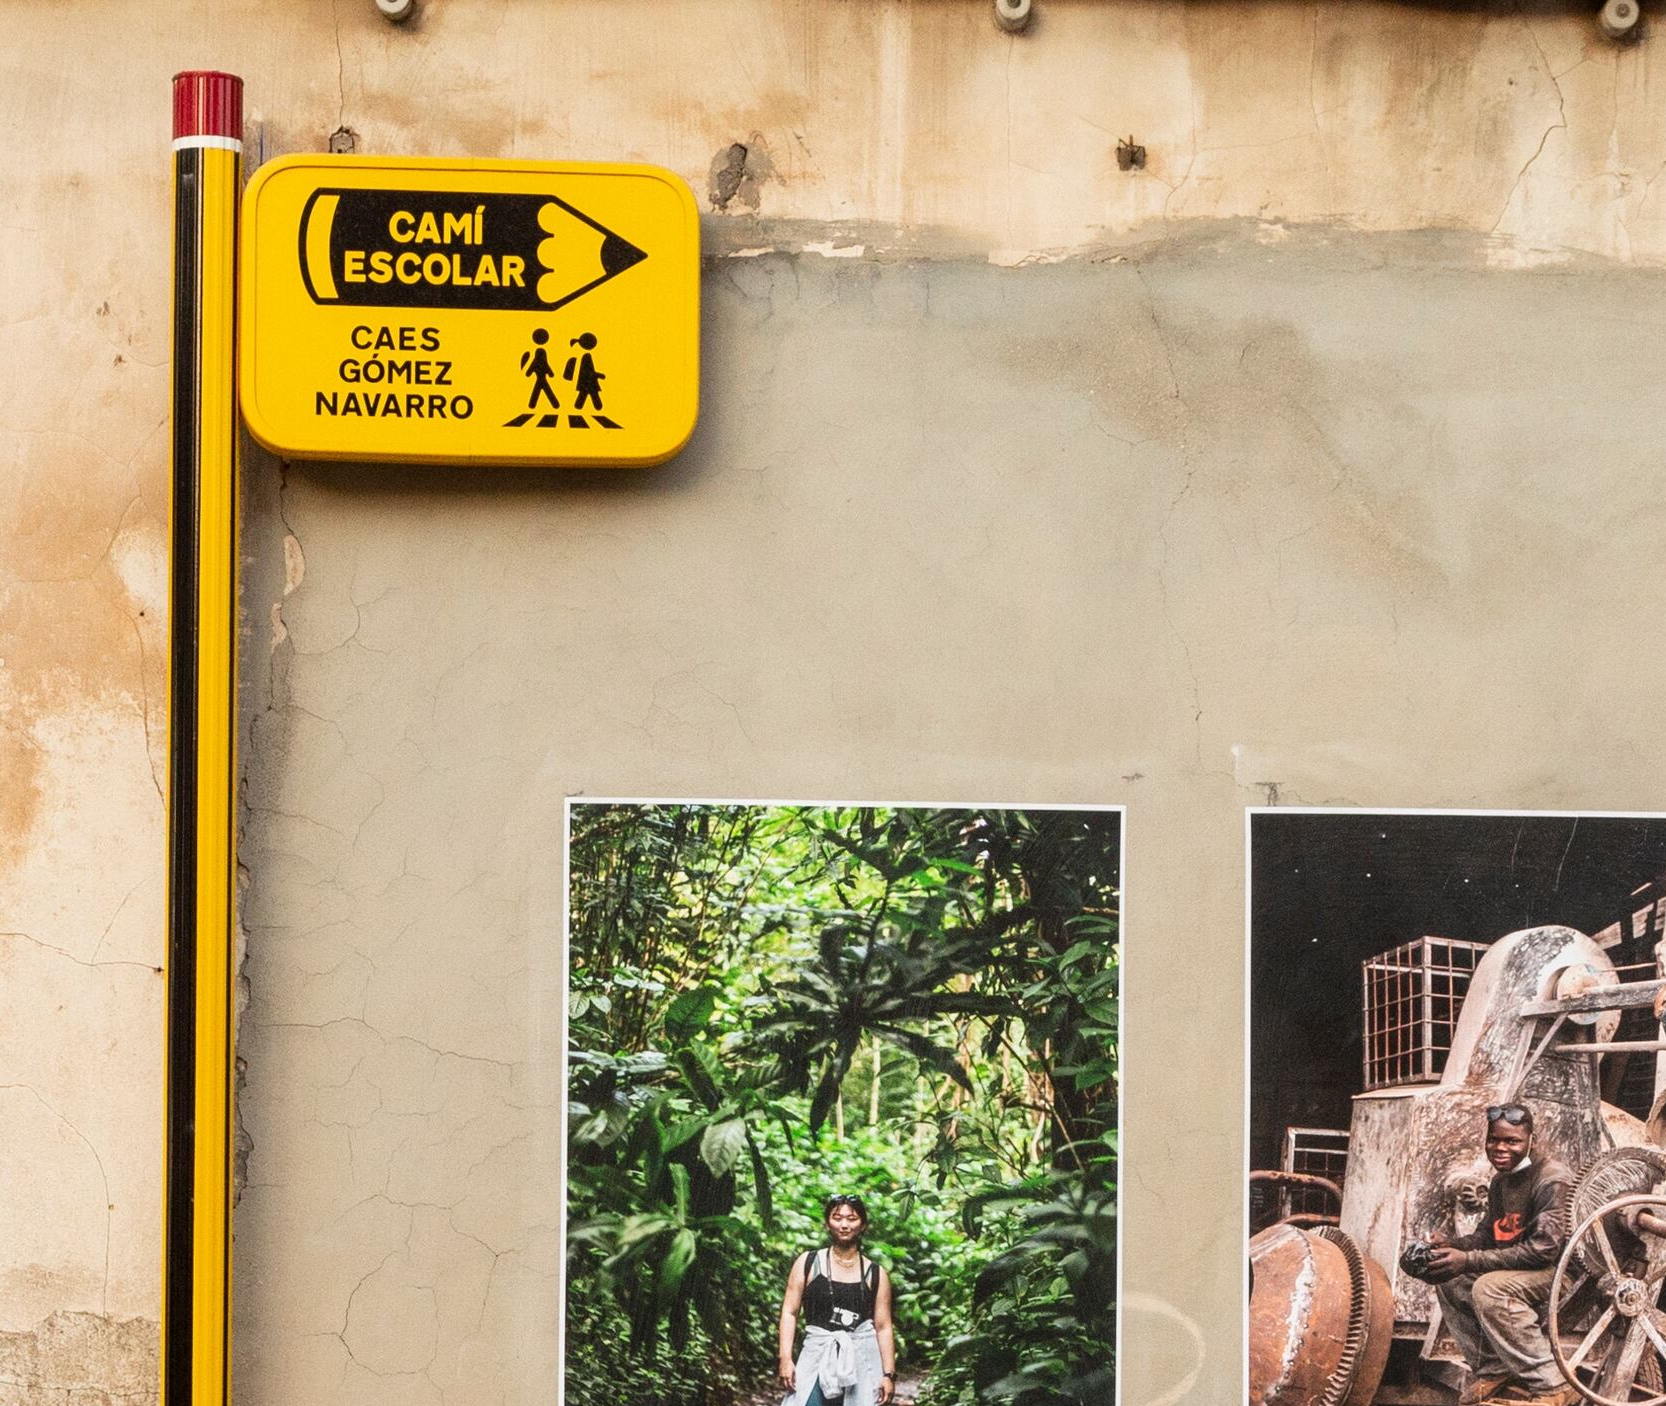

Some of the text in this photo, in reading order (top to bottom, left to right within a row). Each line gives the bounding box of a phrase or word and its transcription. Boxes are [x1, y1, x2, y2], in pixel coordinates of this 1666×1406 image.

[388, 205, 485, 245] CAMÍ
[344, 252, 525, 288] ESCOLAR
[351, 326, 440, 352] CAES
[339, 355, 452, 386] GÓMEZ
[315, 392, 474, 419] NAVARRO
